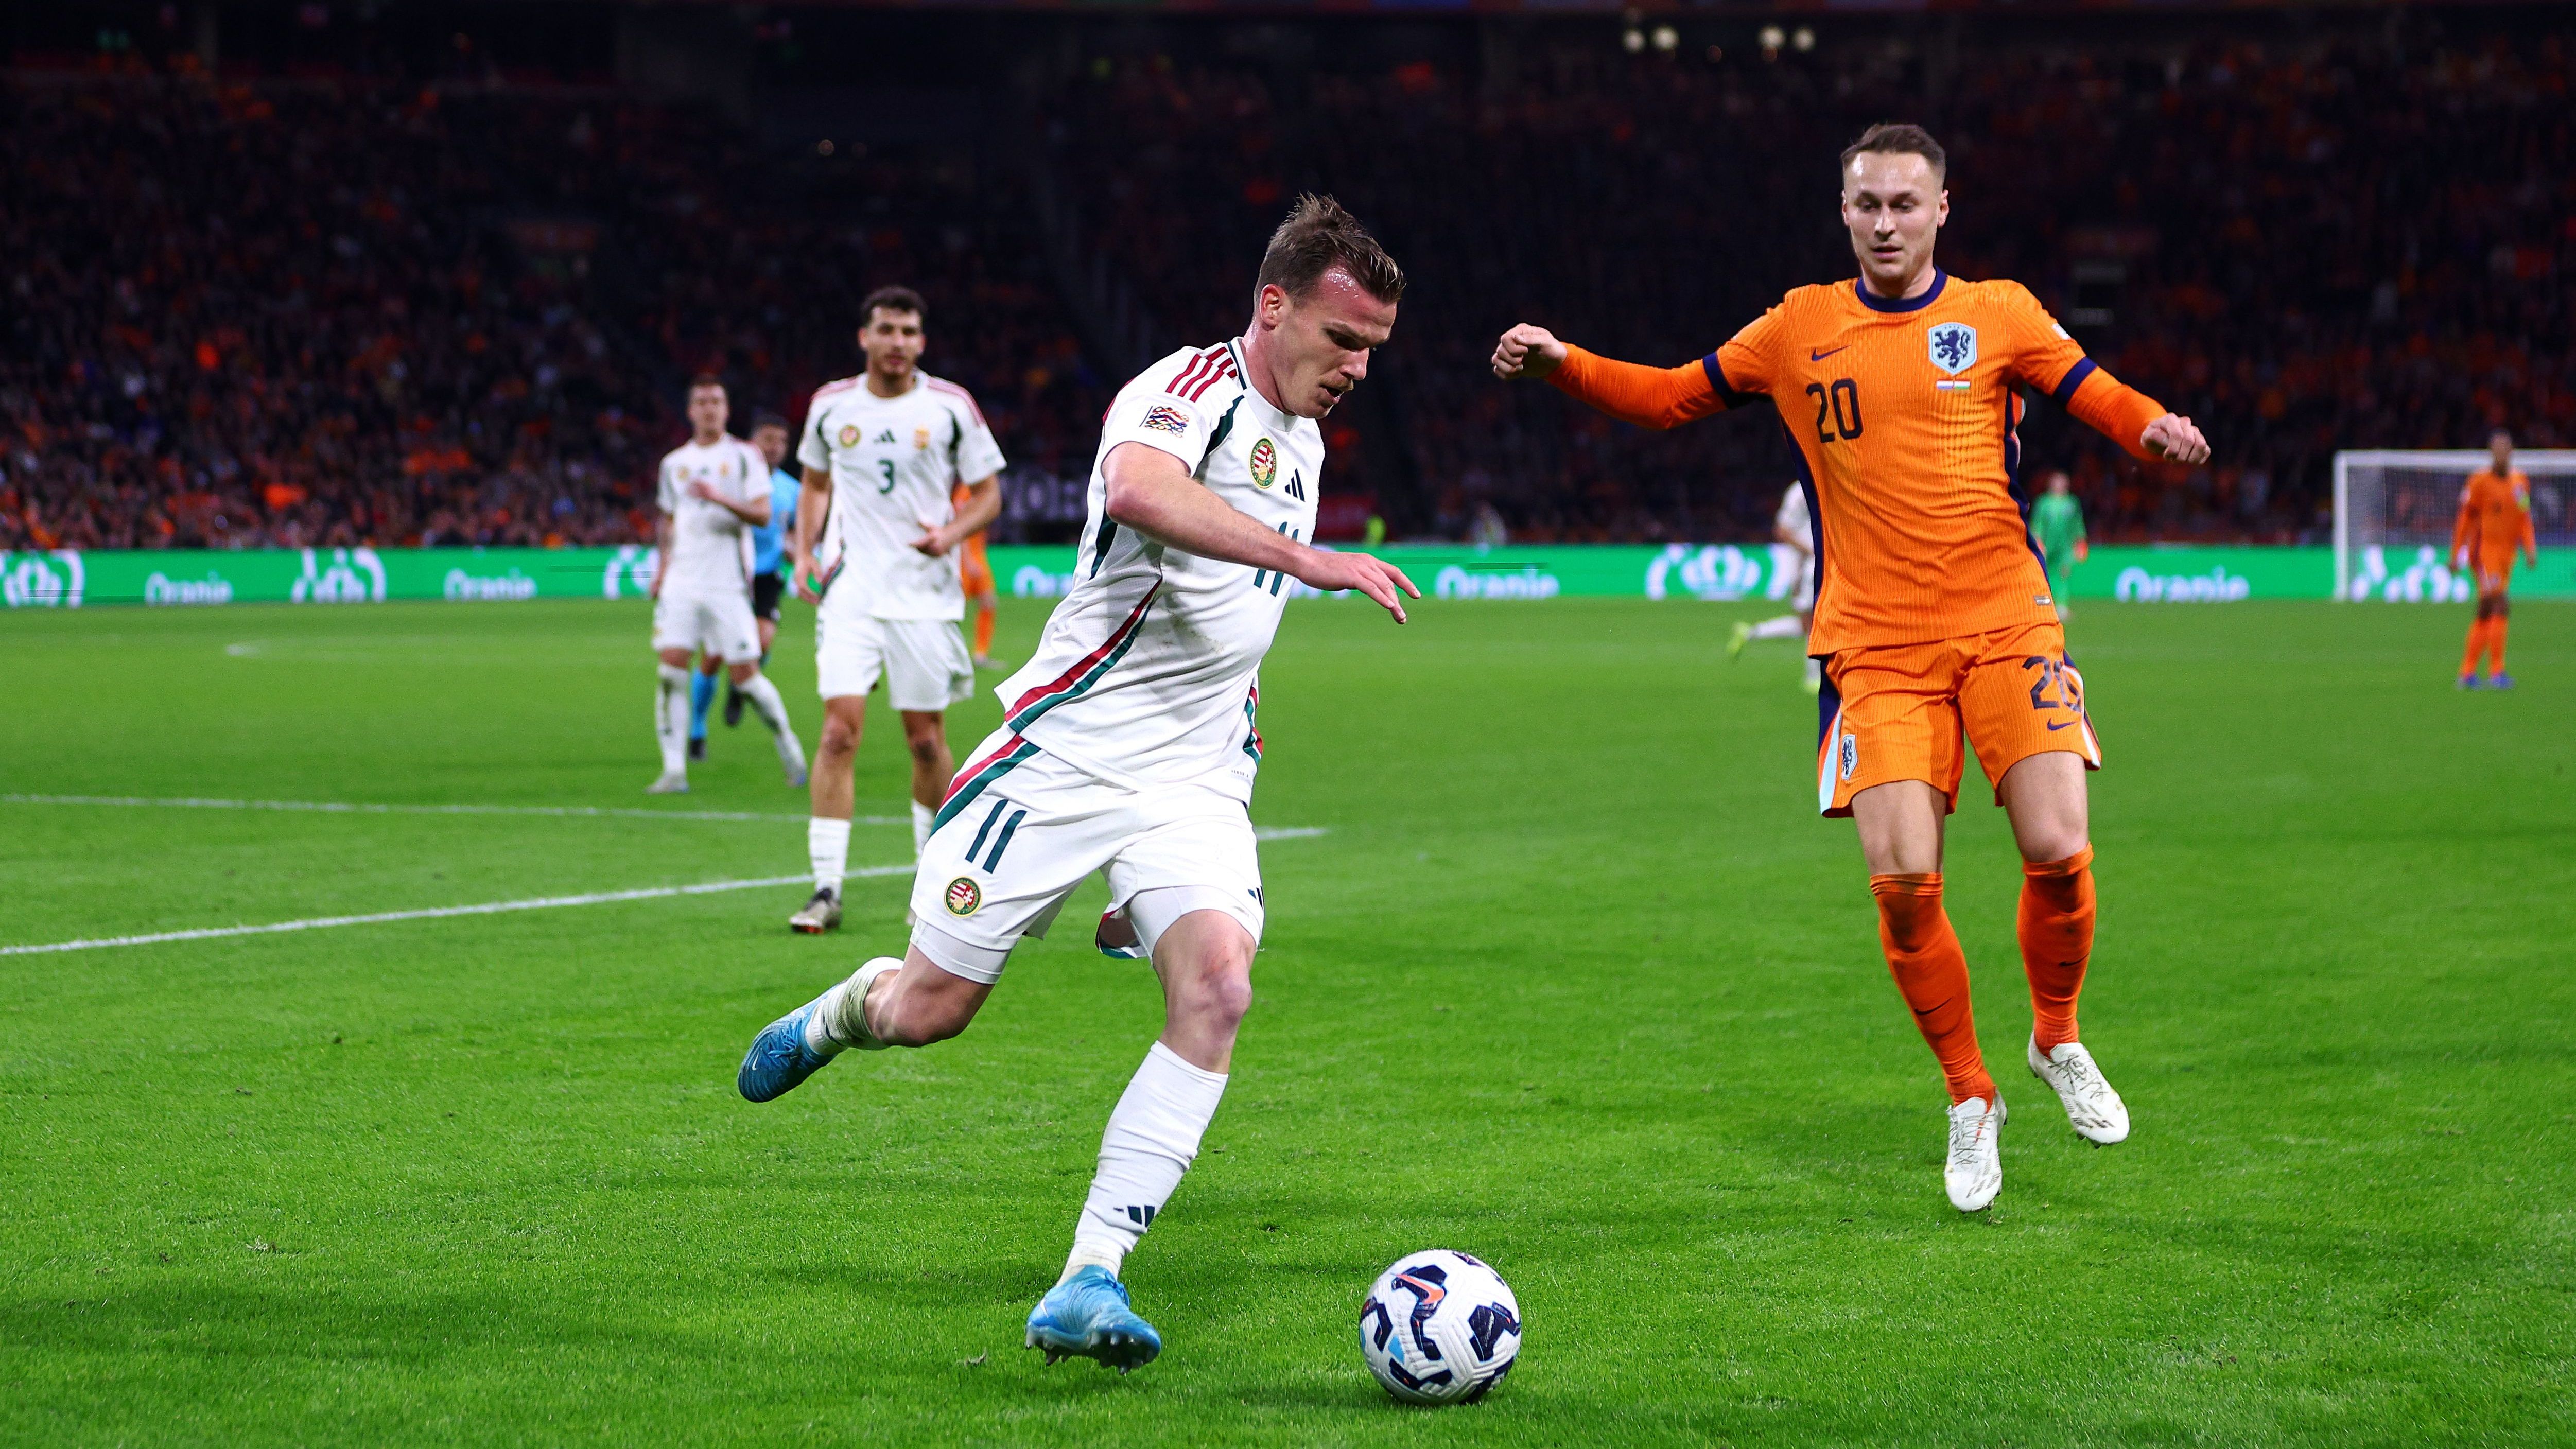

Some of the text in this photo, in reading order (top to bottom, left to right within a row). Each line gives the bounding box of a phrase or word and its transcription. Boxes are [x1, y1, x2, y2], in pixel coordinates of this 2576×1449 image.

[1806, 377, 1864, 443] 20
[879, 460, 895, 494] 3
[2022, 656, 2081, 713] 20
[965, 799, 1028, 874] 11
